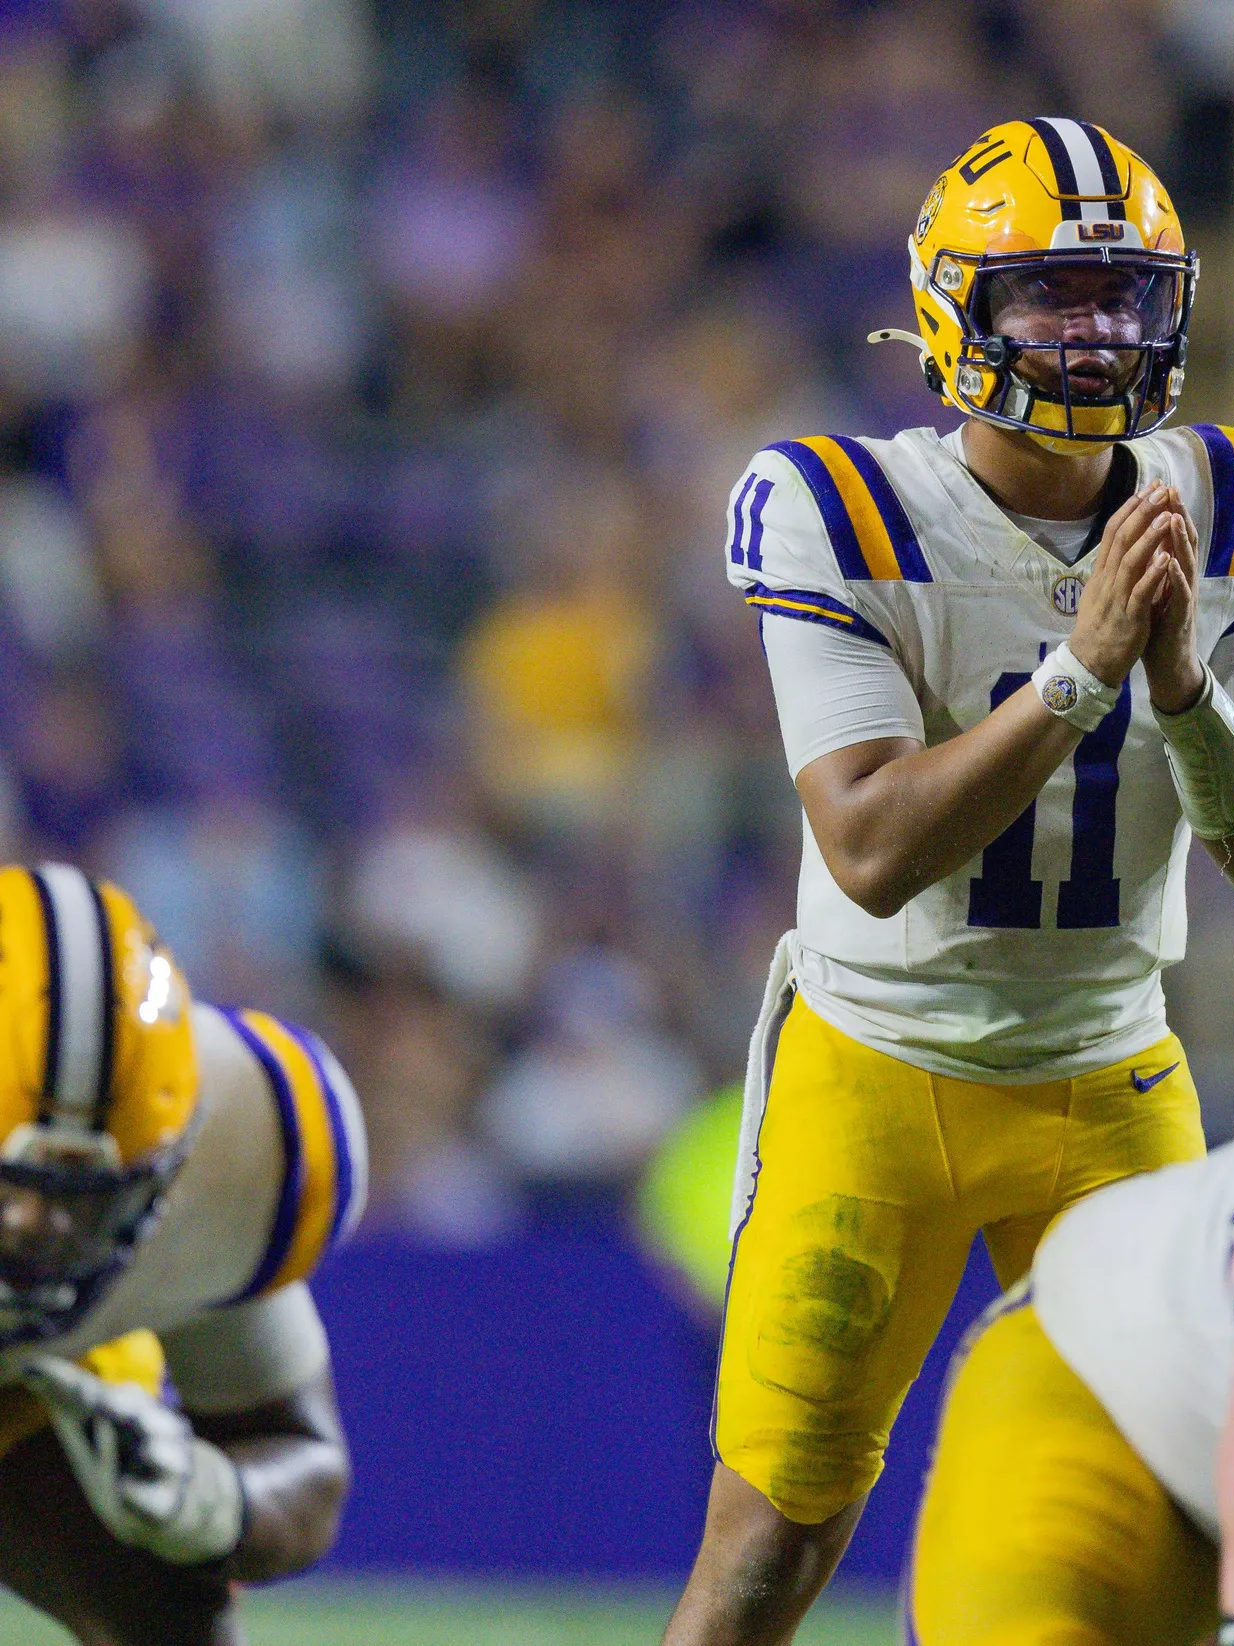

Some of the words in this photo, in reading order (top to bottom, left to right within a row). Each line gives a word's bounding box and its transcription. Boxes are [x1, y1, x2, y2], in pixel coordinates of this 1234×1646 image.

[1076, 223, 1124, 242] LSU
[730, 472, 775, 571] 11
[967, 671, 1132, 929] 11
